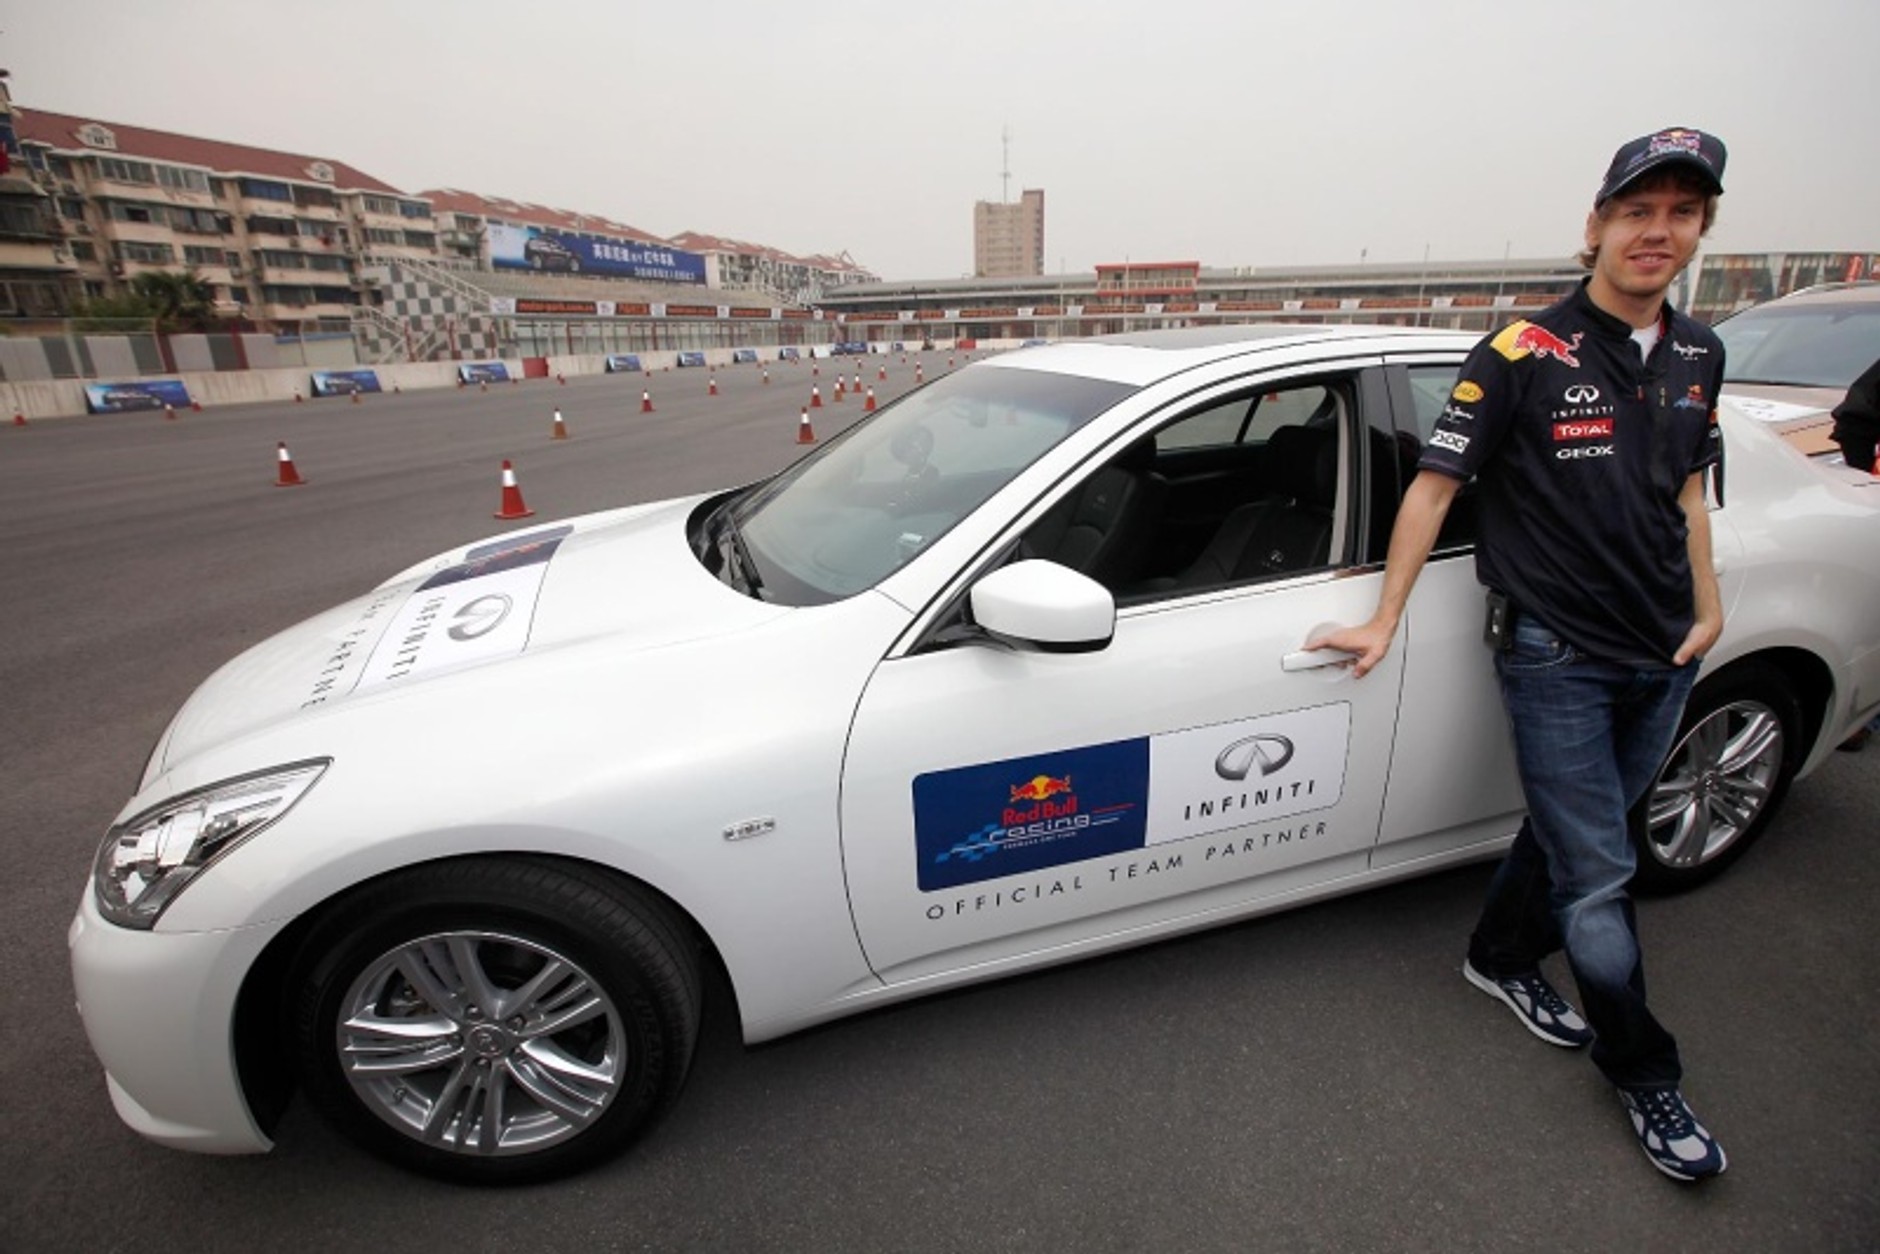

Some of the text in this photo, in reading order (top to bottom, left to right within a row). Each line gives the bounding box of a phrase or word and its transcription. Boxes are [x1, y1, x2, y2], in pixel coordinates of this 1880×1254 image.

[1551, 405, 1614, 419] INFINITI
[1558, 424, 1611, 436] TOTAL
[1555, 444, 1615, 459] GEOX
[1002, 795, 1078, 827] Red Bull
[1184, 780, 1315, 820] INFINITI
[925, 821, 1327, 920] OFFICIAL TEAM PARTNER
